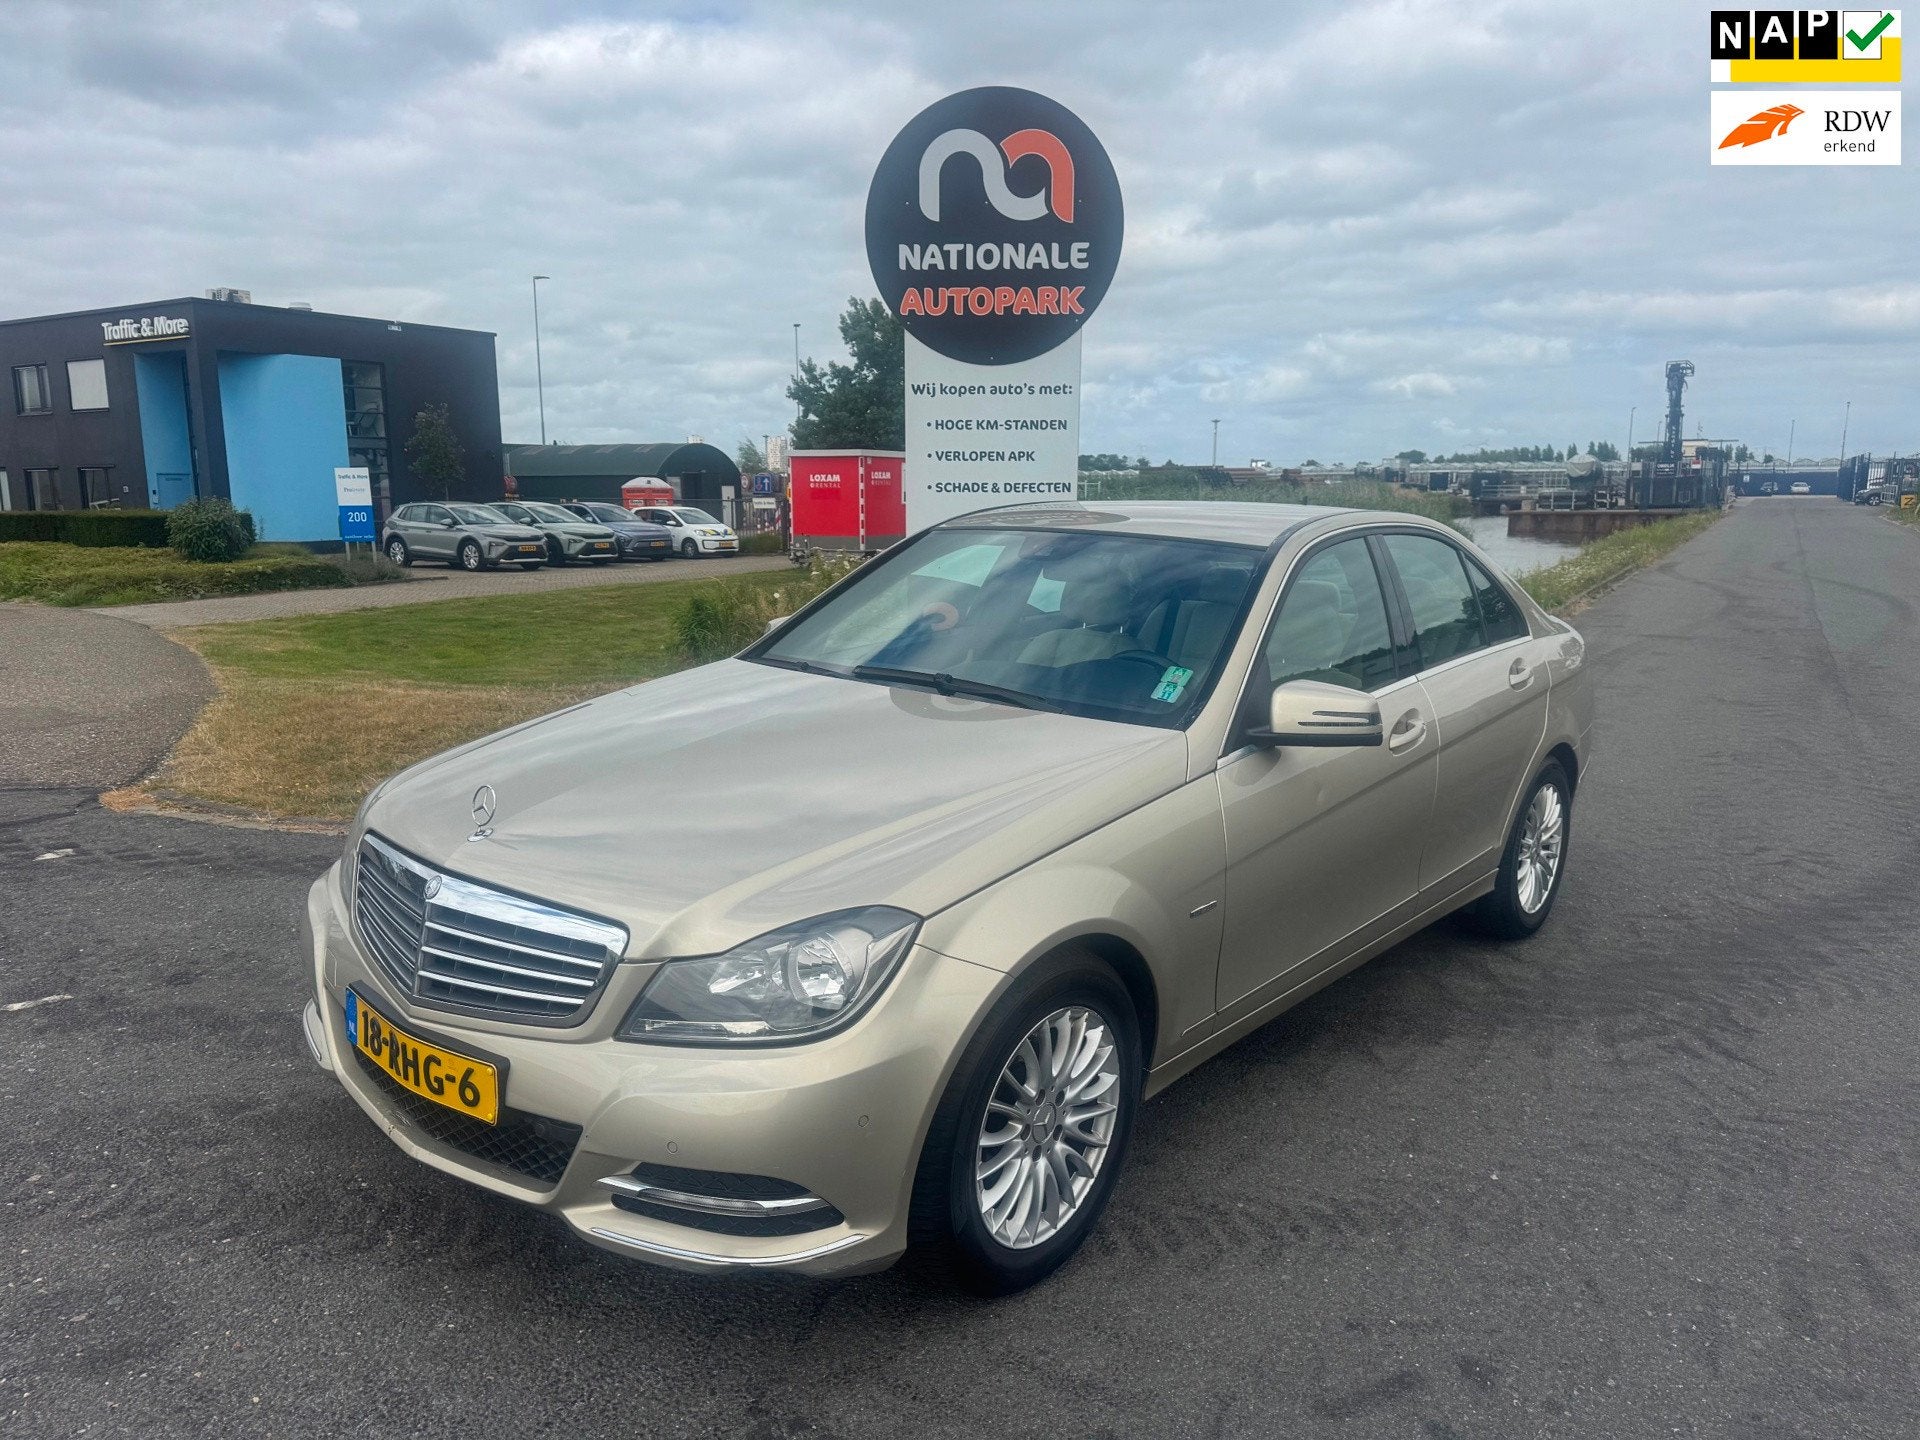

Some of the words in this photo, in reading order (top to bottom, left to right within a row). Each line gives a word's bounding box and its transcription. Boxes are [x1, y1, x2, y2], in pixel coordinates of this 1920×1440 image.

[898, 242, 1090, 271] NATIONALE
[900, 286, 1086, 316] AUTOPARK
[101, 318, 141, 341] Traffic
[140, 317, 154, 337] &
[153, 315, 189, 335] More
[911, 382, 936, 398] Wij
[939, 382, 986, 398] kopen
[989, 382, 1035, 395] auto's
[1038, 382, 1073, 395] met:
[934, 419, 973, 431] HOGE
[976, 419, 1068, 431] KM-STANDEN
[935, 450, 1005, 462] VERLOPEN
[1008, 450, 1036, 462] APK
[809, 474, 841, 482] LOXAM
[935, 482, 988, 493] SCHADE
[991, 482, 1001, 493] &
[1003, 482, 1072, 493] DEFECTEN
[347, 511, 367, 522] 200
[361, 1009, 481, 1108] 18-RHG-6
